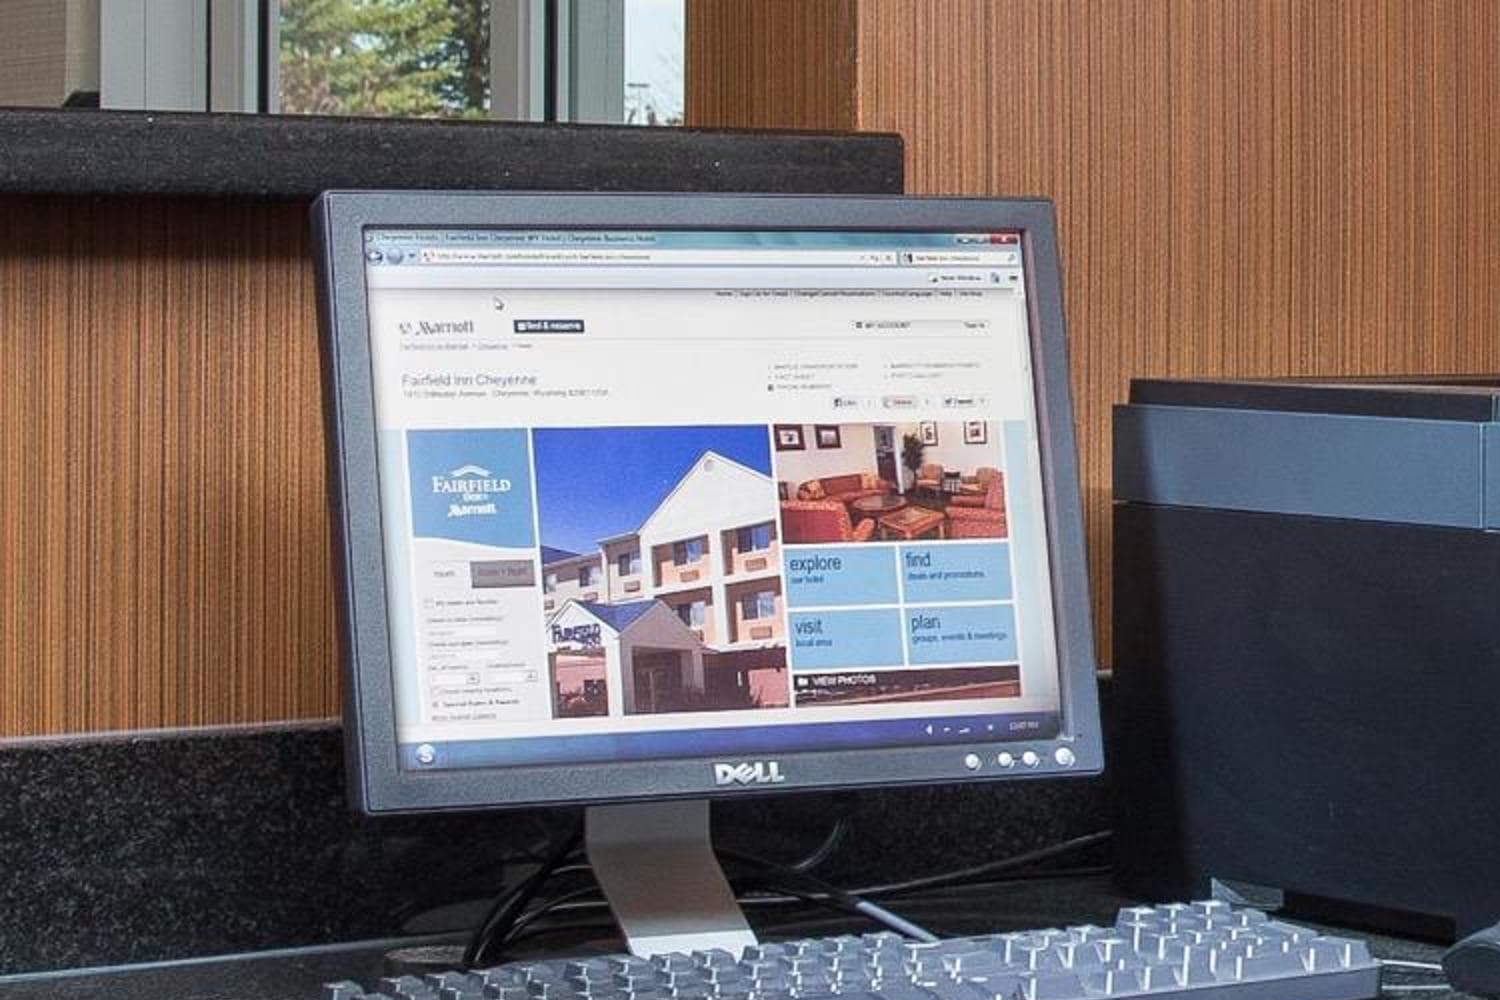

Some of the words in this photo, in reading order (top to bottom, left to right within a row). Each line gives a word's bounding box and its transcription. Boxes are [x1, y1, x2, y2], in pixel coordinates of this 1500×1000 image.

[402, 373, 451, 387] Fairfield
[454, 374, 474, 387] Inn
[475, 373, 538, 389] Cheyenne
[431, 475, 512, 494] FAIRFIELD
[789, 553, 843, 576] explore
[904, 551, 931, 569] find
[795, 619, 823, 636] visit
[911, 614, 941, 634] plan
[811, 675, 836, 687] VIEW
[836, 673, 877, 686] PHOTOS
[714, 761, 785, 785] DELL
